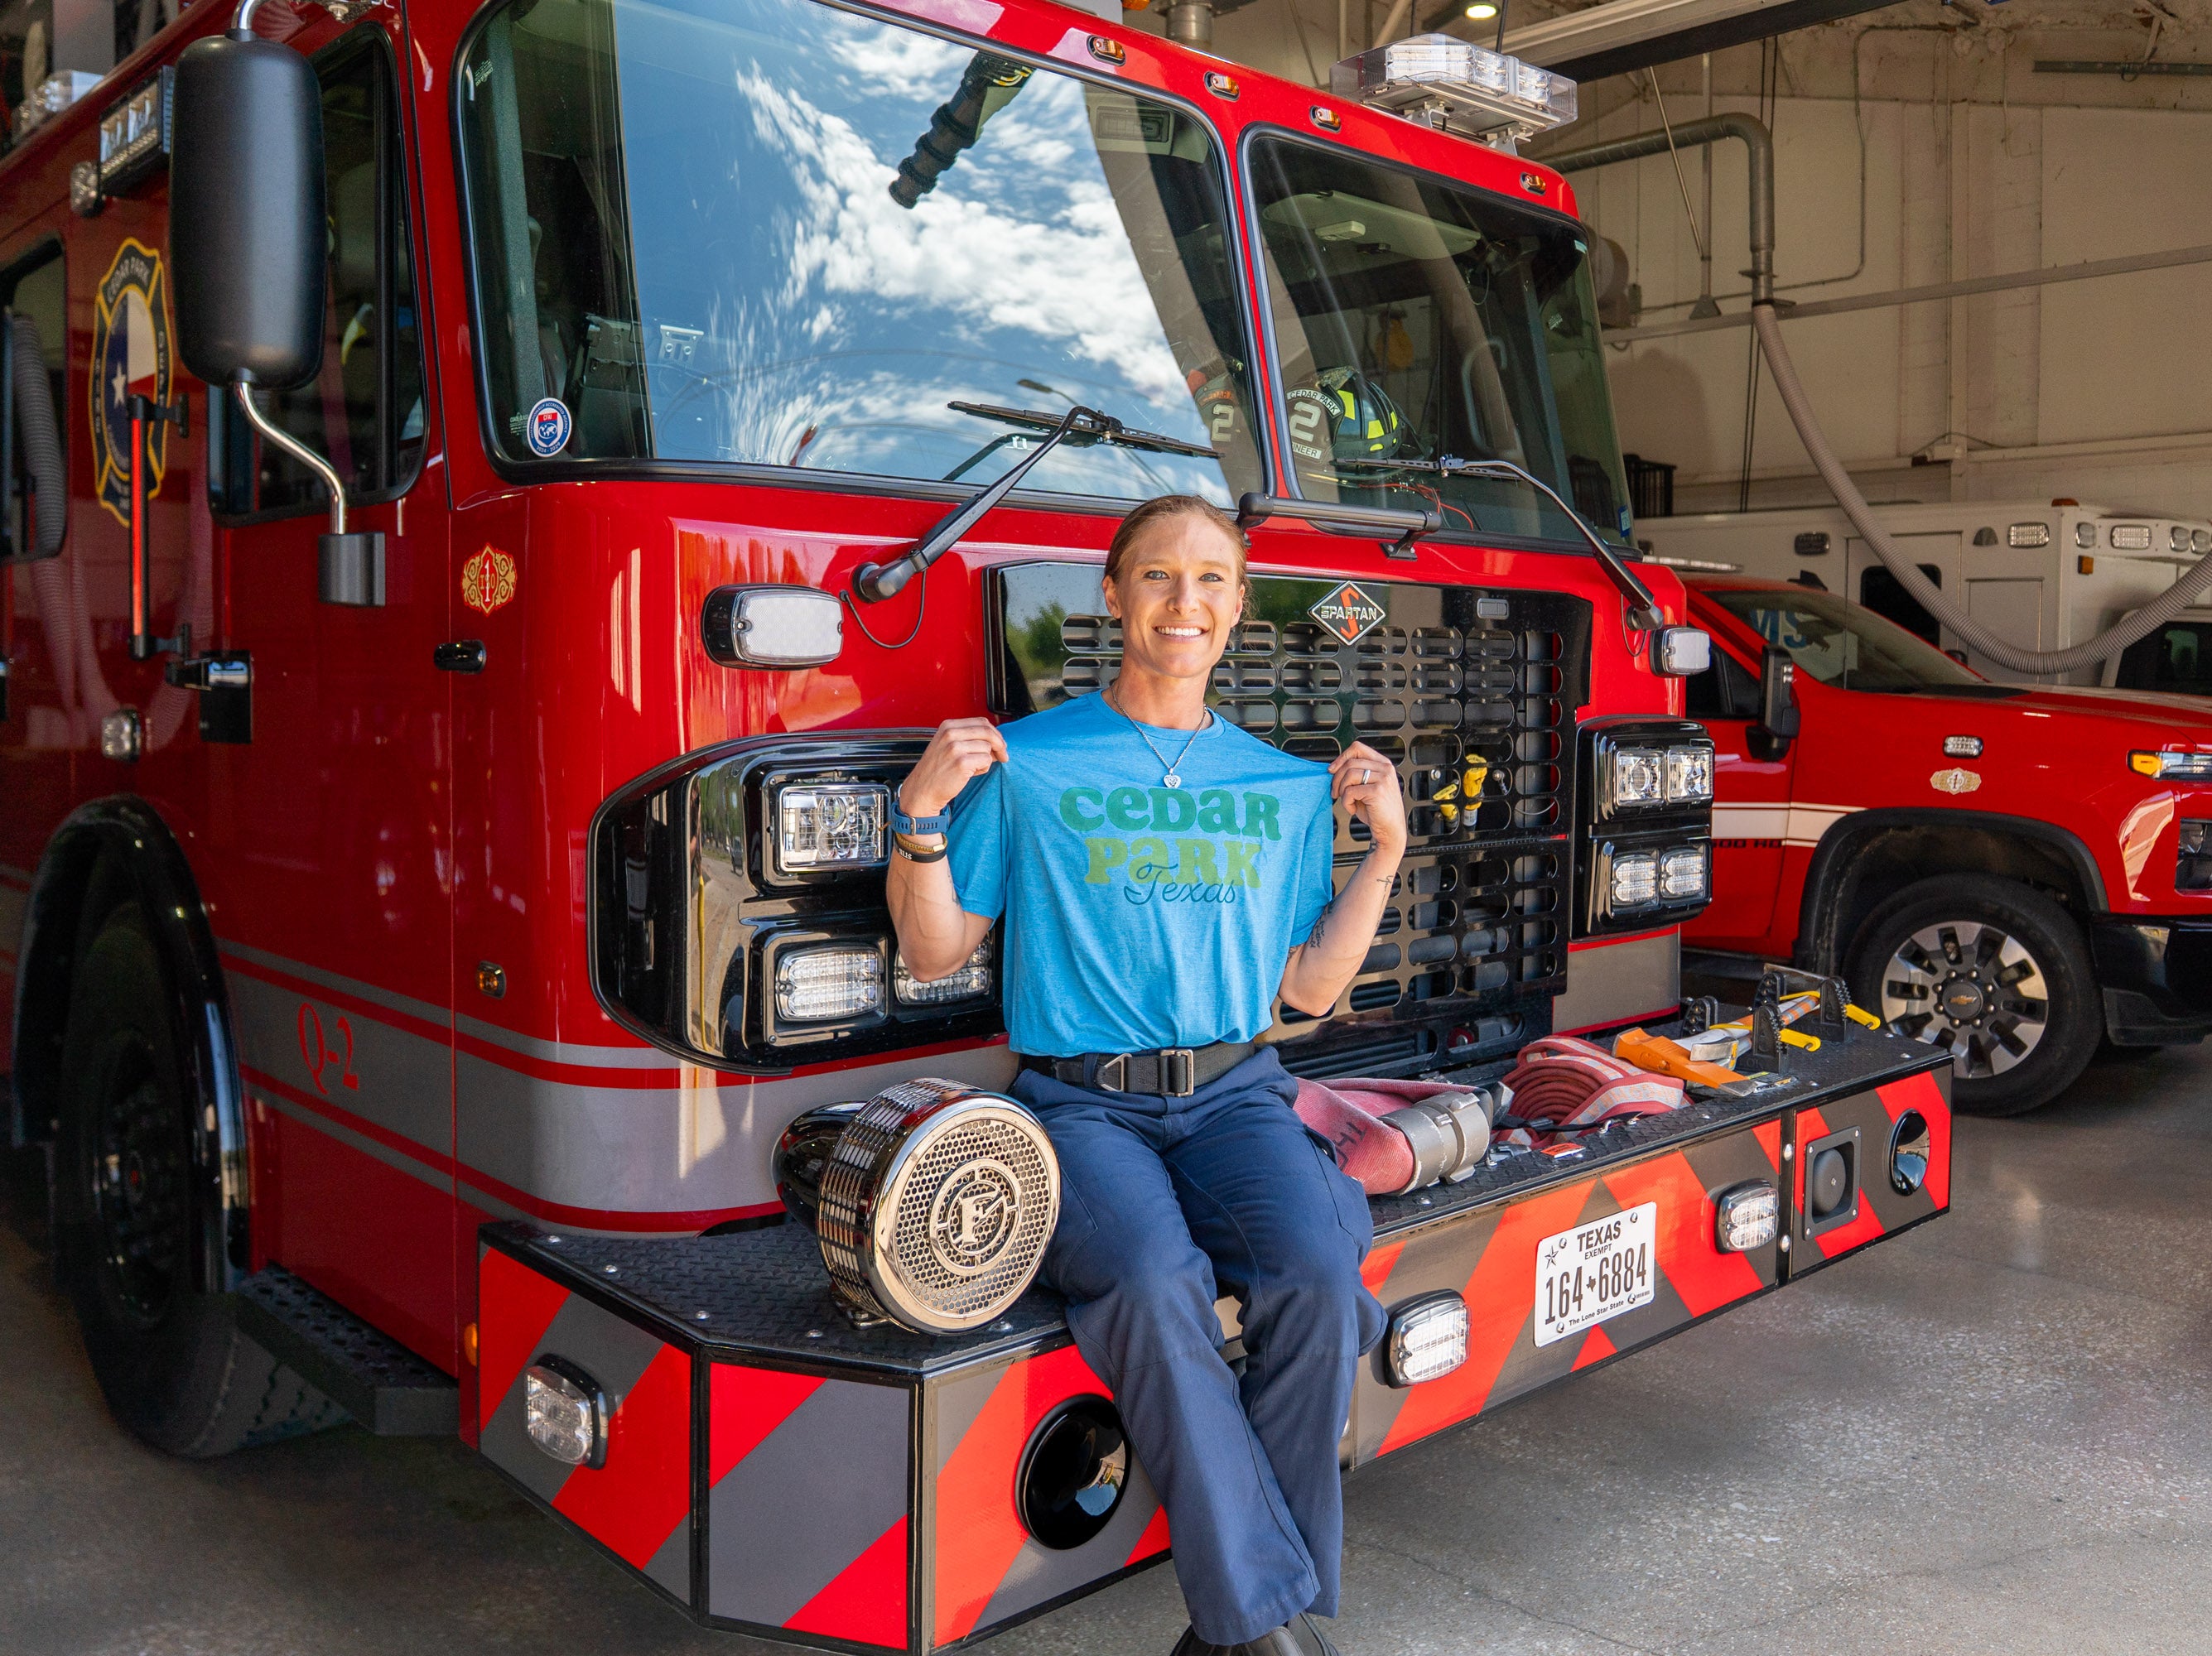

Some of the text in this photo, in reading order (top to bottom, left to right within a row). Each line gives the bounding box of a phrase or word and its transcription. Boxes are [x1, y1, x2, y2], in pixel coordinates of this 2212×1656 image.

[1290, 390, 1339, 414] CEDAR PARK
[1212, 403, 1235, 442] 2
[1289, 402, 1322, 442] 2
[1320, 605, 1377, 620] SPARTAN
[1123, 862, 1237, 906] Texas
[1577, 1220, 1622, 1252] TEXAS
[1584, 1243, 1612, 1260] EXEMPT
[1569, 1299, 1624, 1326] The Lone Star State
